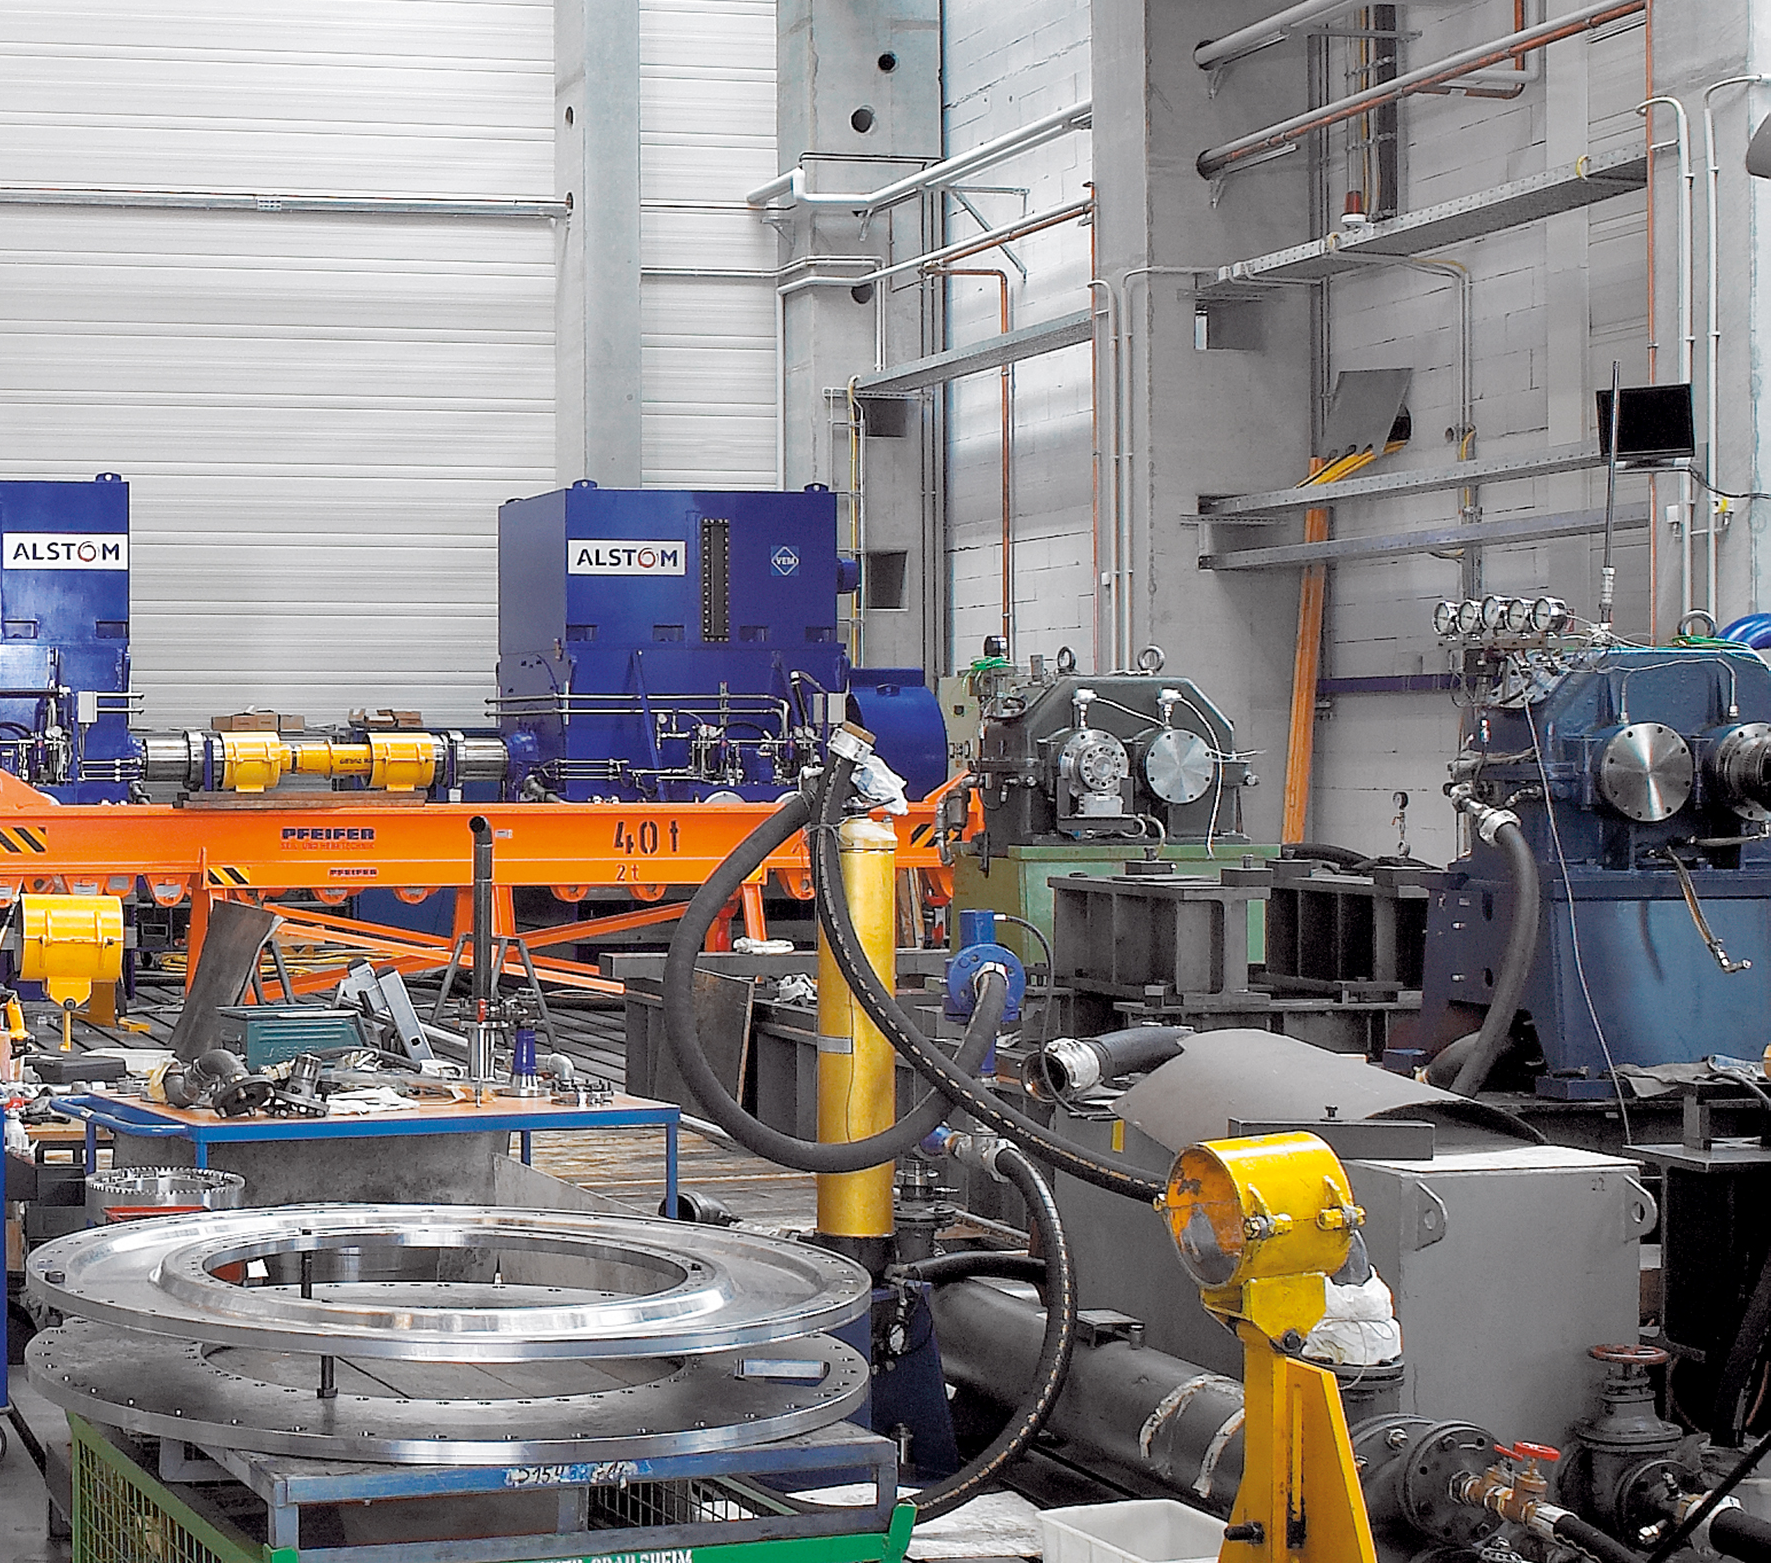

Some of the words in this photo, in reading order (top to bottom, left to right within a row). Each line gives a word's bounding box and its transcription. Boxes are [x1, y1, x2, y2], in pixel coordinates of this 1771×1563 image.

[13, 541, 120, 563] ALSTOM
[576, 547, 678, 568] ALSTOM
[282, 828, 374, 840] PFEIFER
[613, 821, 658, 854] 40
[616, 864, 626, 882] 2
